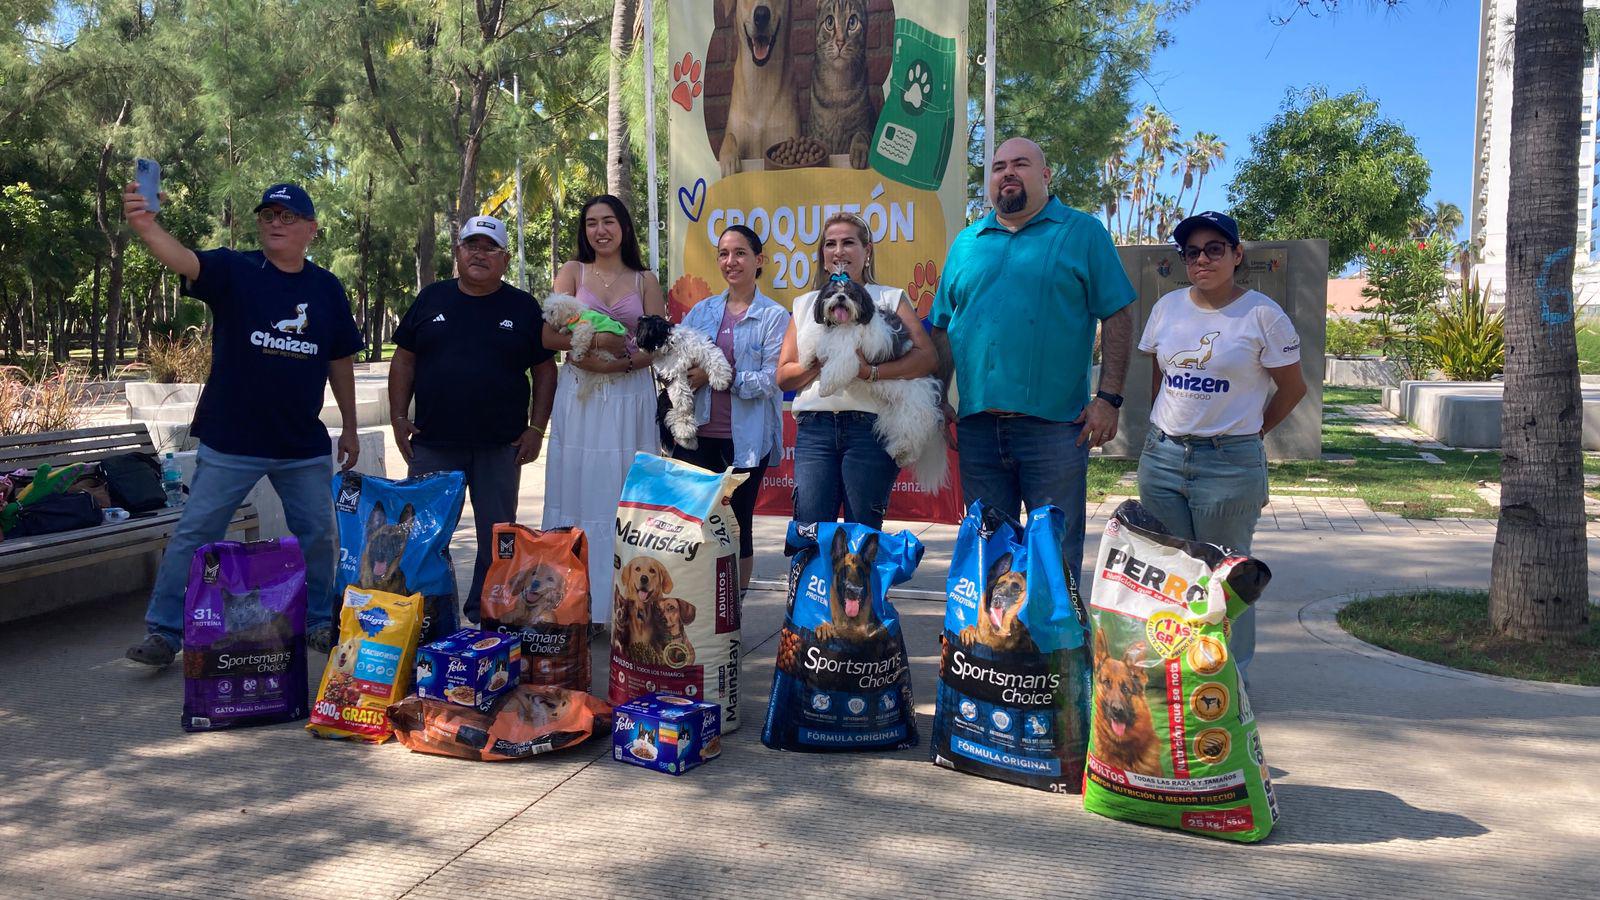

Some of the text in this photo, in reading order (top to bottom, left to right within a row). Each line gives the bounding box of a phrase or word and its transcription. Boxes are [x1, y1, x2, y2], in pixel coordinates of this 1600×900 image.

[250, 330, 319, 356] Chaizen
[1164, 369, 1230, 393] haizen
[615, 516, 702, 562] Mainstay
[530, 643, 561, 654] Choice
[217, 651, 292, 670] Sportsman's
[257, 662, 288, 673] Choice
[951, 650, 1061, 689] Sportsman's
[726, 638, 741, 722] Mainstay
[1001, 687, 1052, 705] Choice
[1172, 688, 1180, 701] se
[215, 706, 235, 714] GATO
[341, 706, 385, 726] GRATIS
[1173, 703, 1183, 724] que
[615, 716, 636, 734] felix
[807, 730, 900, 742] FÓRMULA ORIGINAL
[957, 739, 1052, 771] FÓRMULA ORIGINAL
[1174, 724, 1188, 773] Nutrición
[1133, 774, 1157, 784] TODAS
[1157, 779, 1171, 787] LAS
[1172, 779, 1197, 787] RAZAS
[1204, 773, 1238, 785] TAMAÑOS
[1112, 784, 1156, 801] NUTRICIÓN
[1165, 795, 1198, 804] MENOR
[1188, 818, 1205, 829] 25
